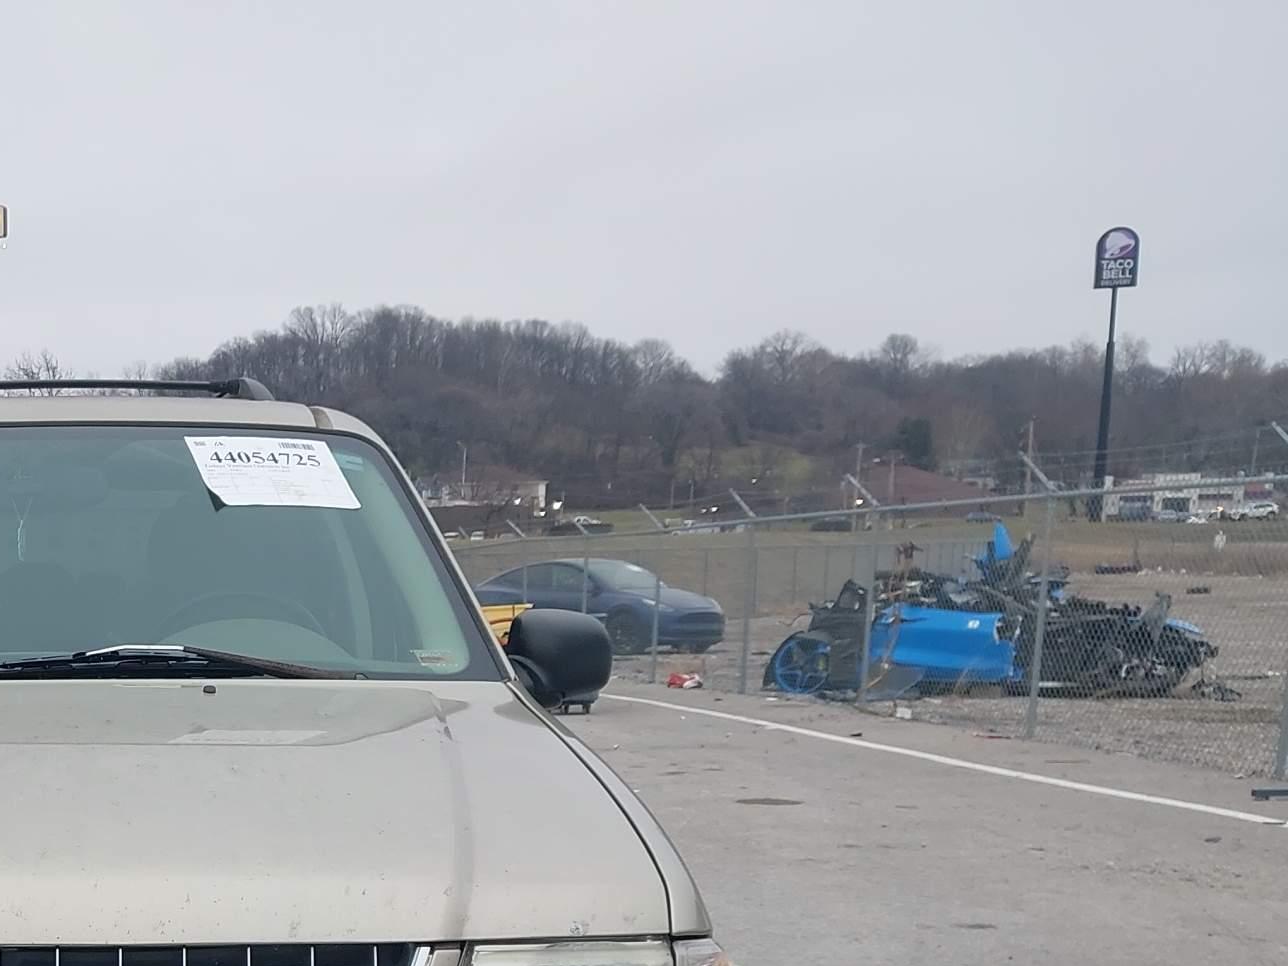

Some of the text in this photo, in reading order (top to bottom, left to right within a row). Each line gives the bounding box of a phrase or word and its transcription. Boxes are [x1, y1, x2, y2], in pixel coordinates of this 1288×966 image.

[1101, 258, 1134, 270] TACO
[1103, 268, 1133, 280] BELL
[210, 451, 321, 467] 44054725
